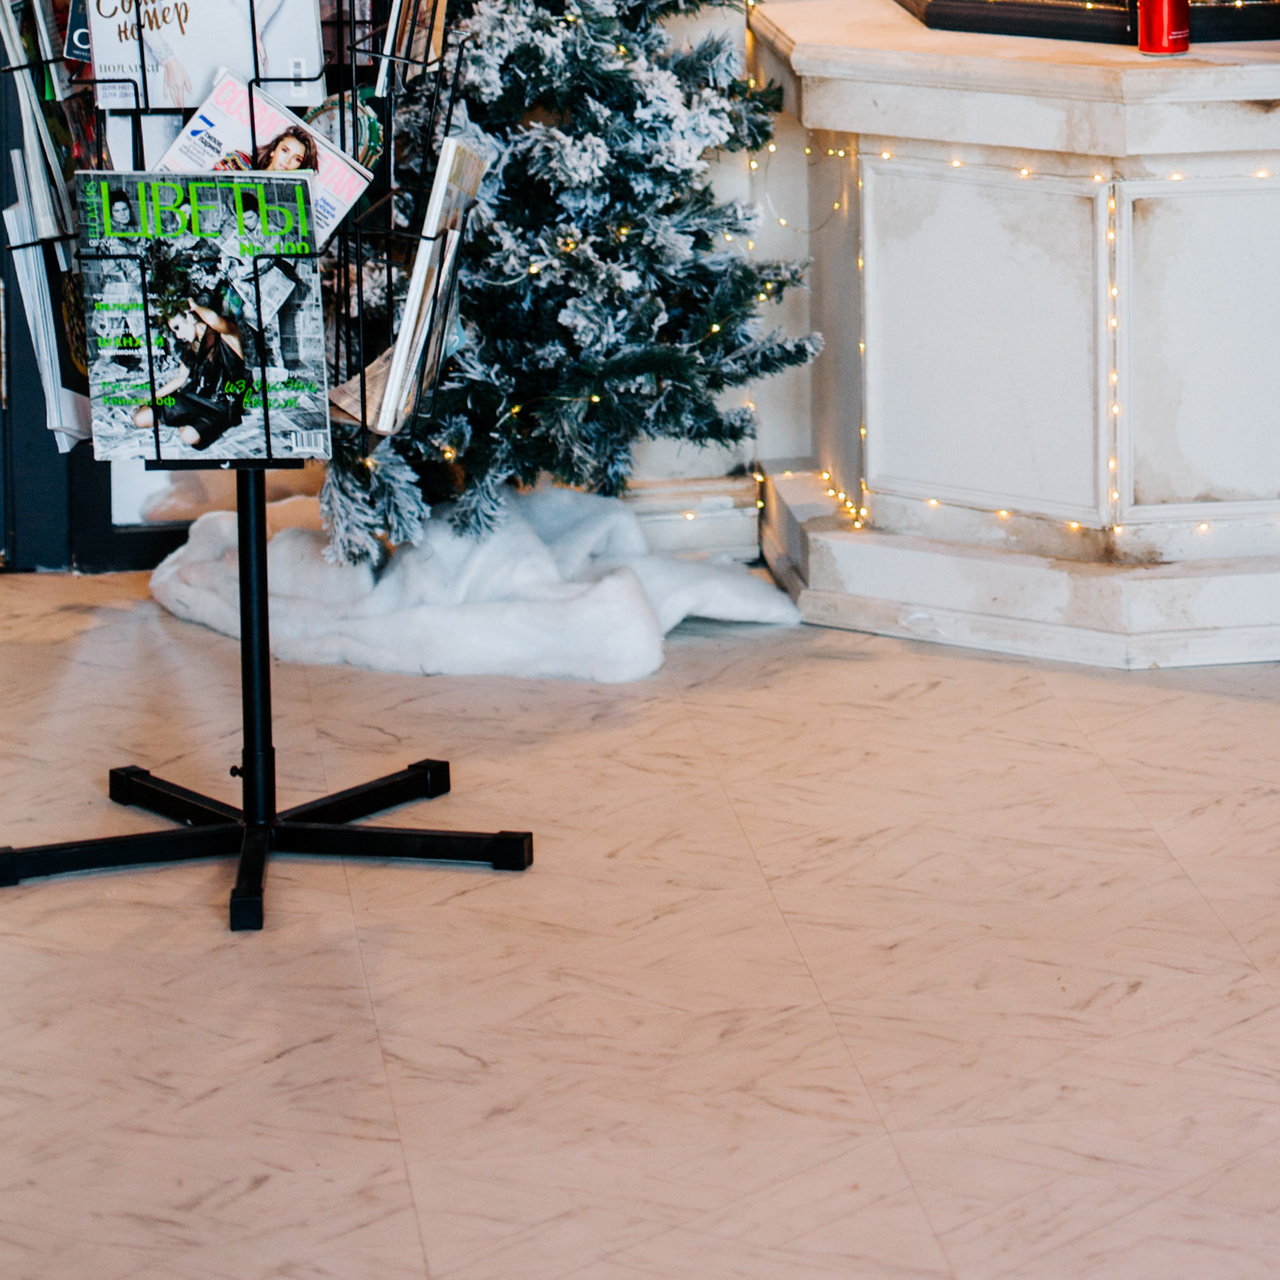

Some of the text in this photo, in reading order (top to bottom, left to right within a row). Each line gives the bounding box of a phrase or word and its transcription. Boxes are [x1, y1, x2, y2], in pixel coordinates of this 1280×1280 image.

[190, 114, 215, 137] 7
[100, 180, 309, 240] ЦВЕТЫ
[272, 241, 310, 255] 100
[101, 381, 152, 394] Русски
